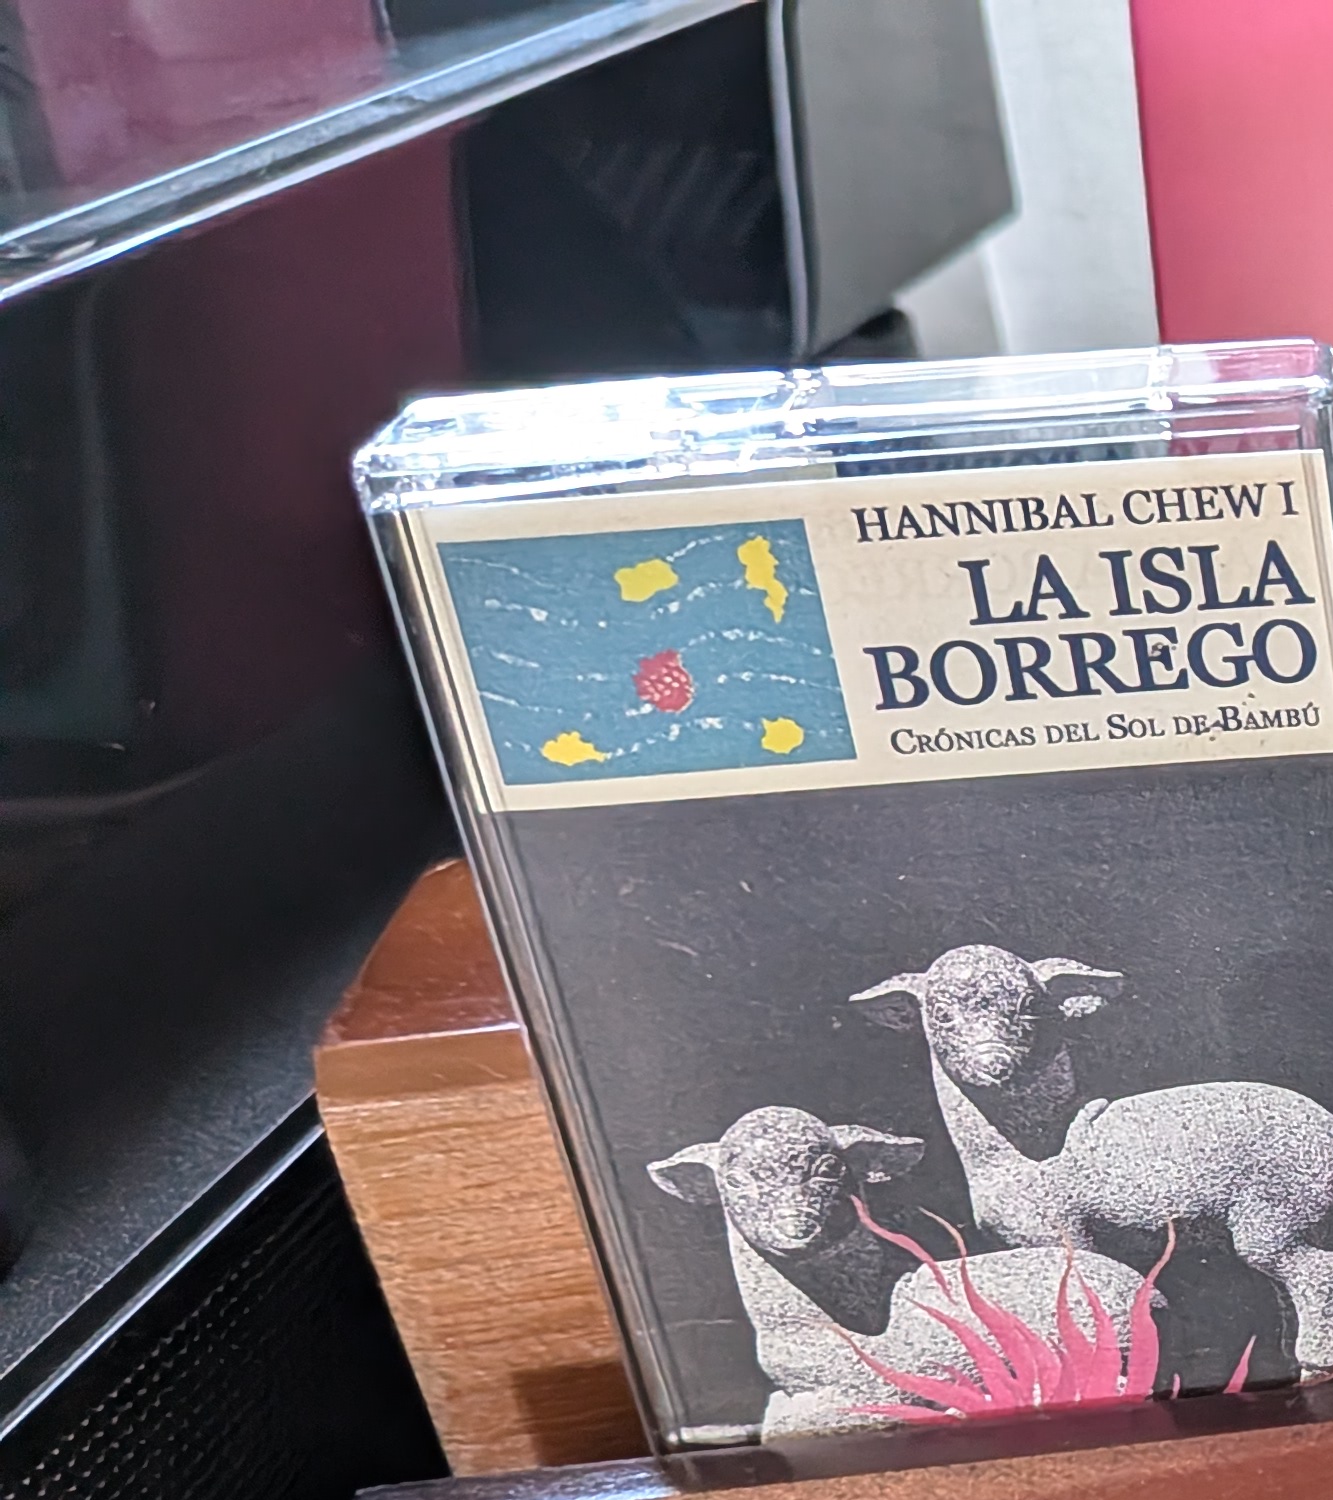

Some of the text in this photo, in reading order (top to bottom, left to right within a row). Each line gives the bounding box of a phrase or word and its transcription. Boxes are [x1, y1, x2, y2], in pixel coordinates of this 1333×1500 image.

[850, 481, 1299, 543] HANNIBAL CHEW I
[957, 540, 1316, 626] LA ISLA
[862, 618, 1318, 711] BORREGO
[889, 725, 1037, 756] CRÓNICAS
[1046, 721, 1100, 745] DEL
[1107, 713, 1166, 740] SOL
